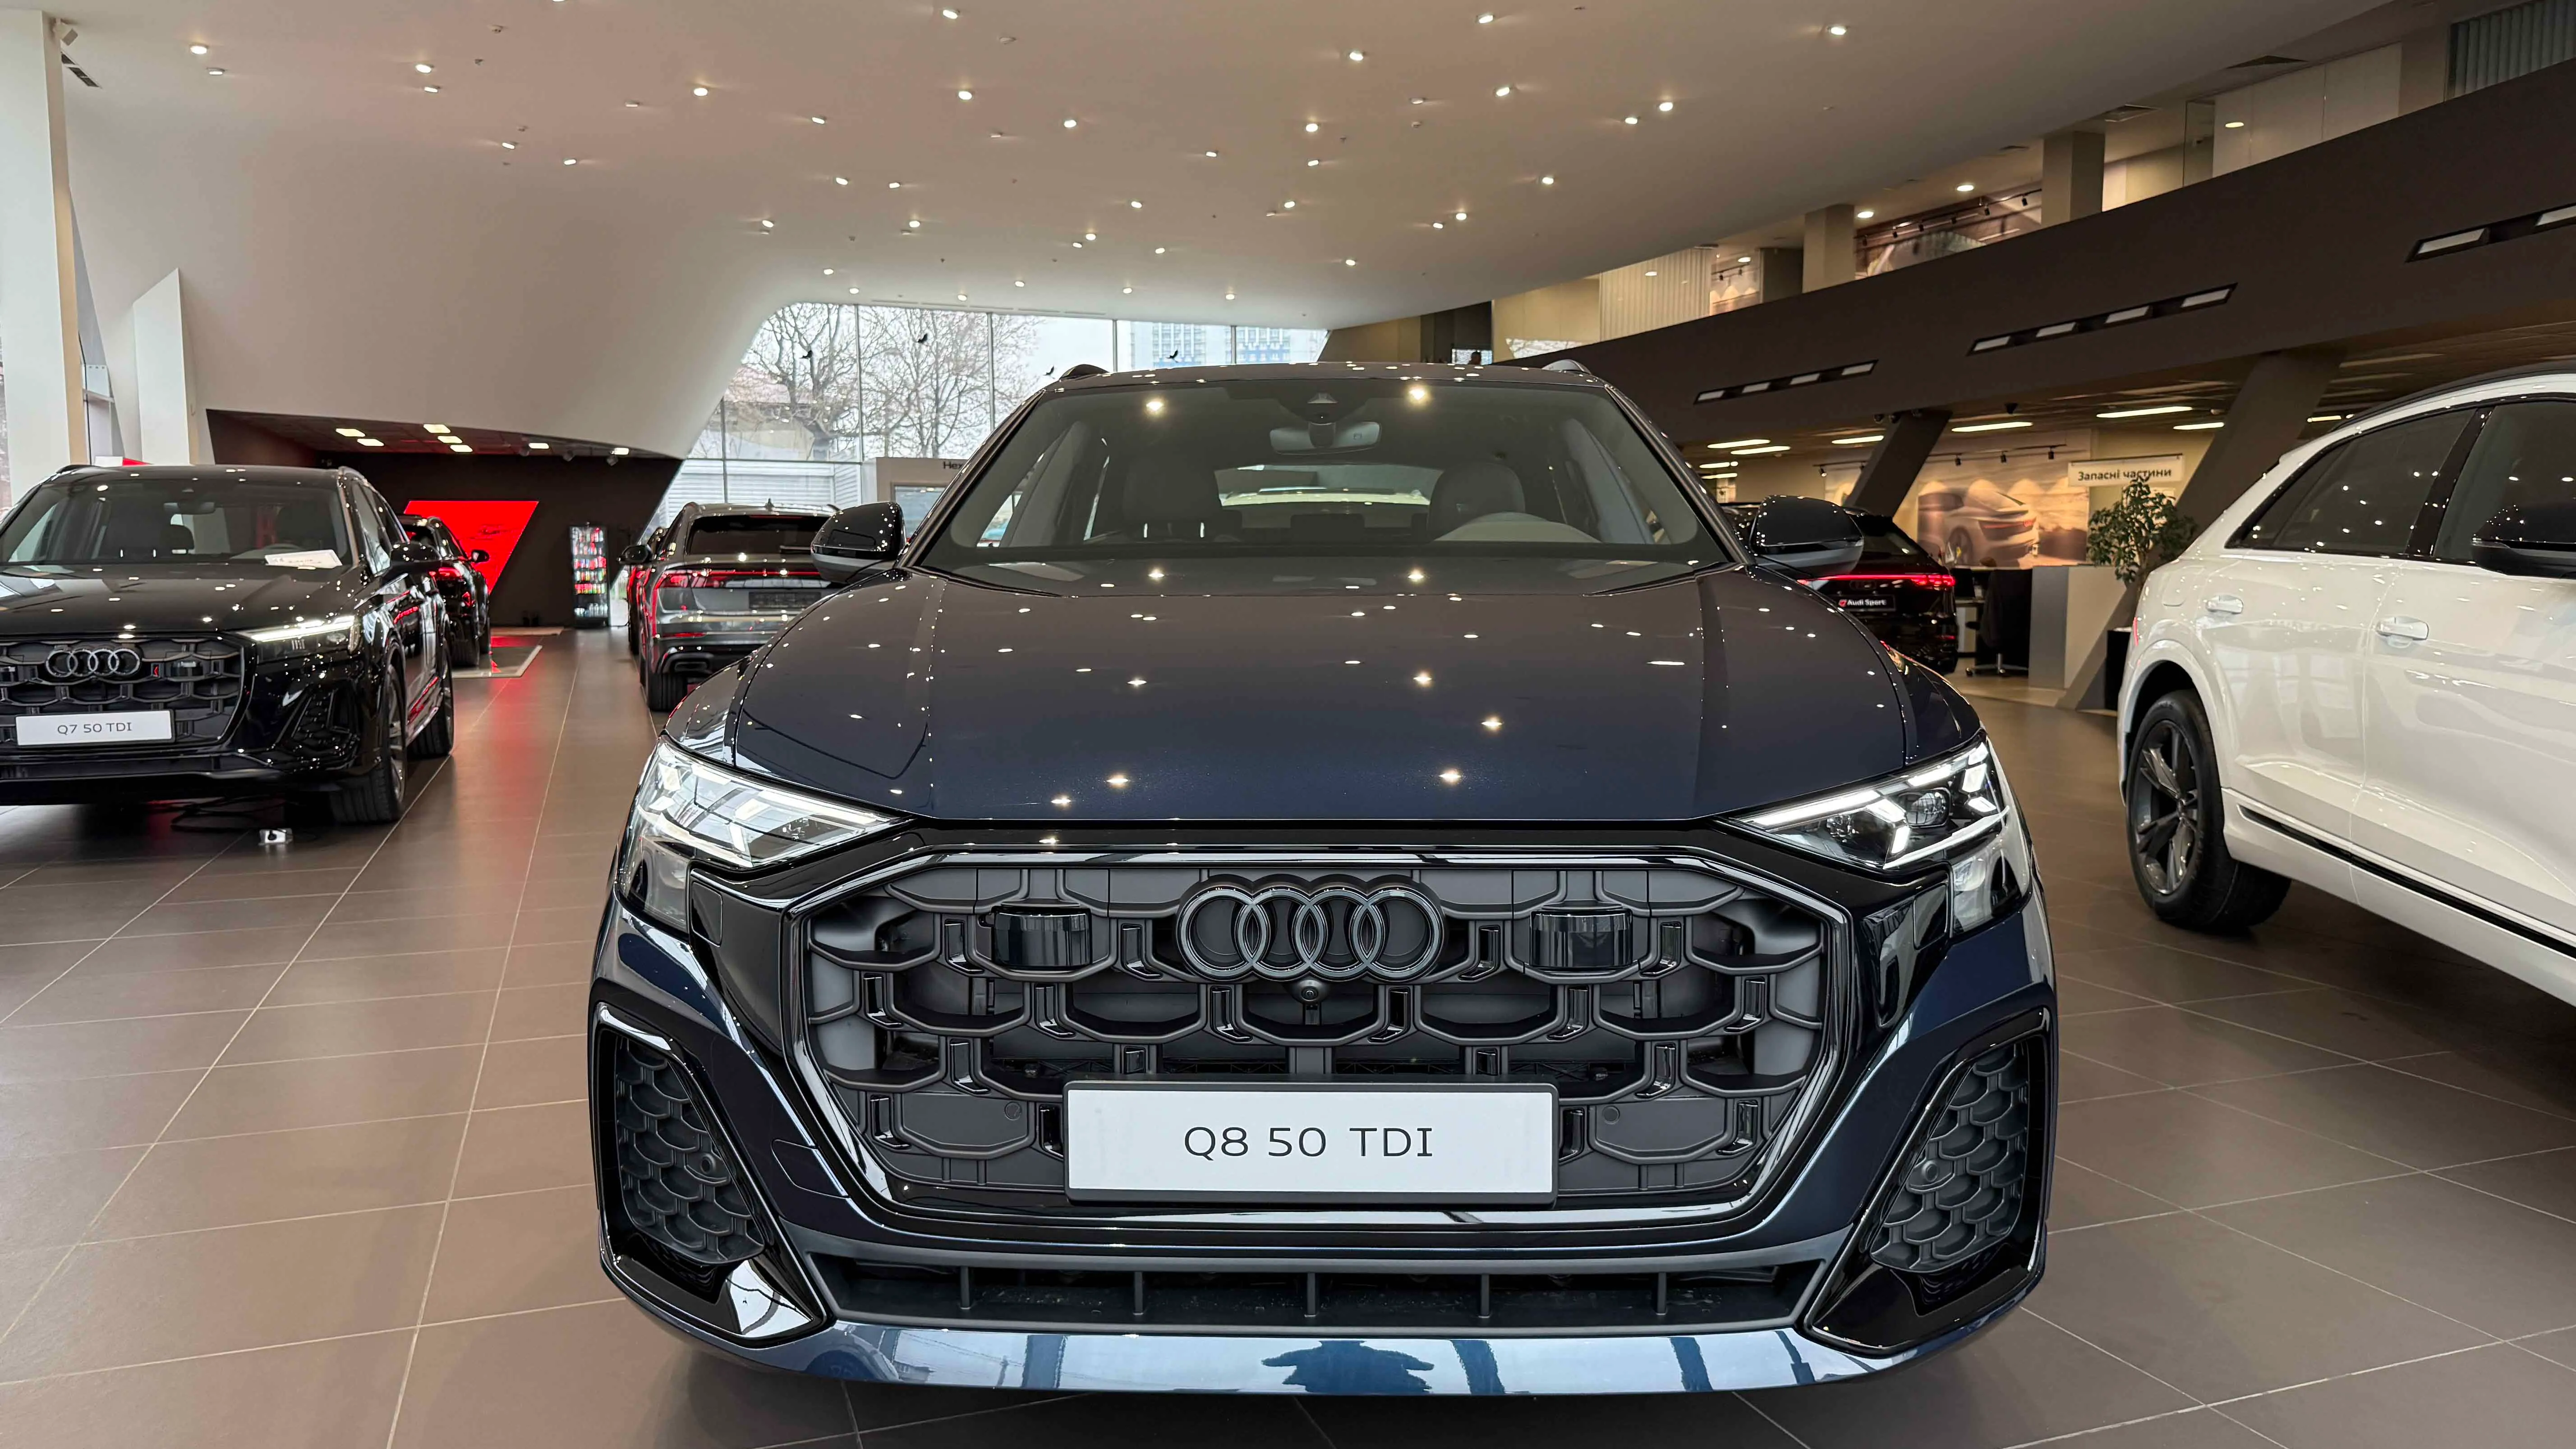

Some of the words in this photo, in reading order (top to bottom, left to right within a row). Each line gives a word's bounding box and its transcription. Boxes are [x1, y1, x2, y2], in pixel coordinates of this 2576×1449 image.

[2078, 469, 2120, 481] Запасні
[2123, 469, 2171, 478] частини
[57, 724, 77, 735] Q7
[83, 723, 102, 733] 50
[106, 722, 132, 732] TDI
[1184, 1127, 1248, 1161] Q8
[1268, 1127, 1326, 1157] 50
[1349, 1128, 1433, 1157] TDI
